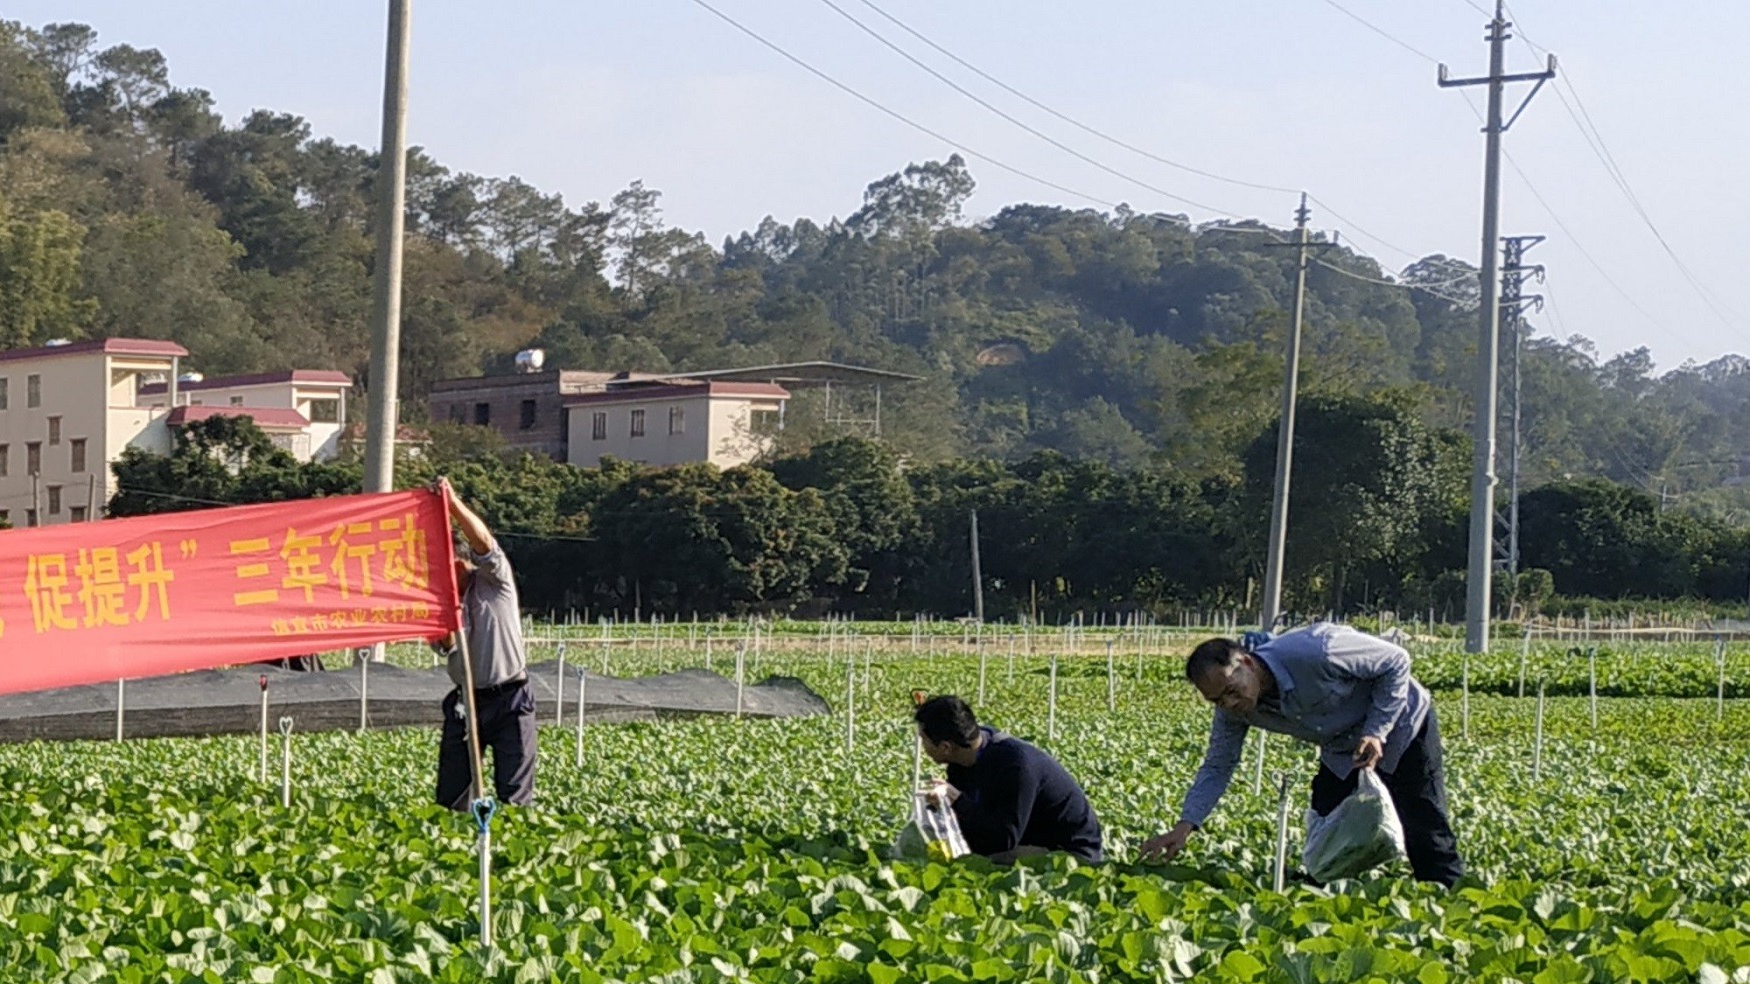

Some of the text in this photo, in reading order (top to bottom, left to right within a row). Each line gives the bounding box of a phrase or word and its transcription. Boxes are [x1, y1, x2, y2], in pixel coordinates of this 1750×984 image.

[229, 513, 429, 607] 三年行动
[271, 601, 429, 637] 信宜市农业农村局
